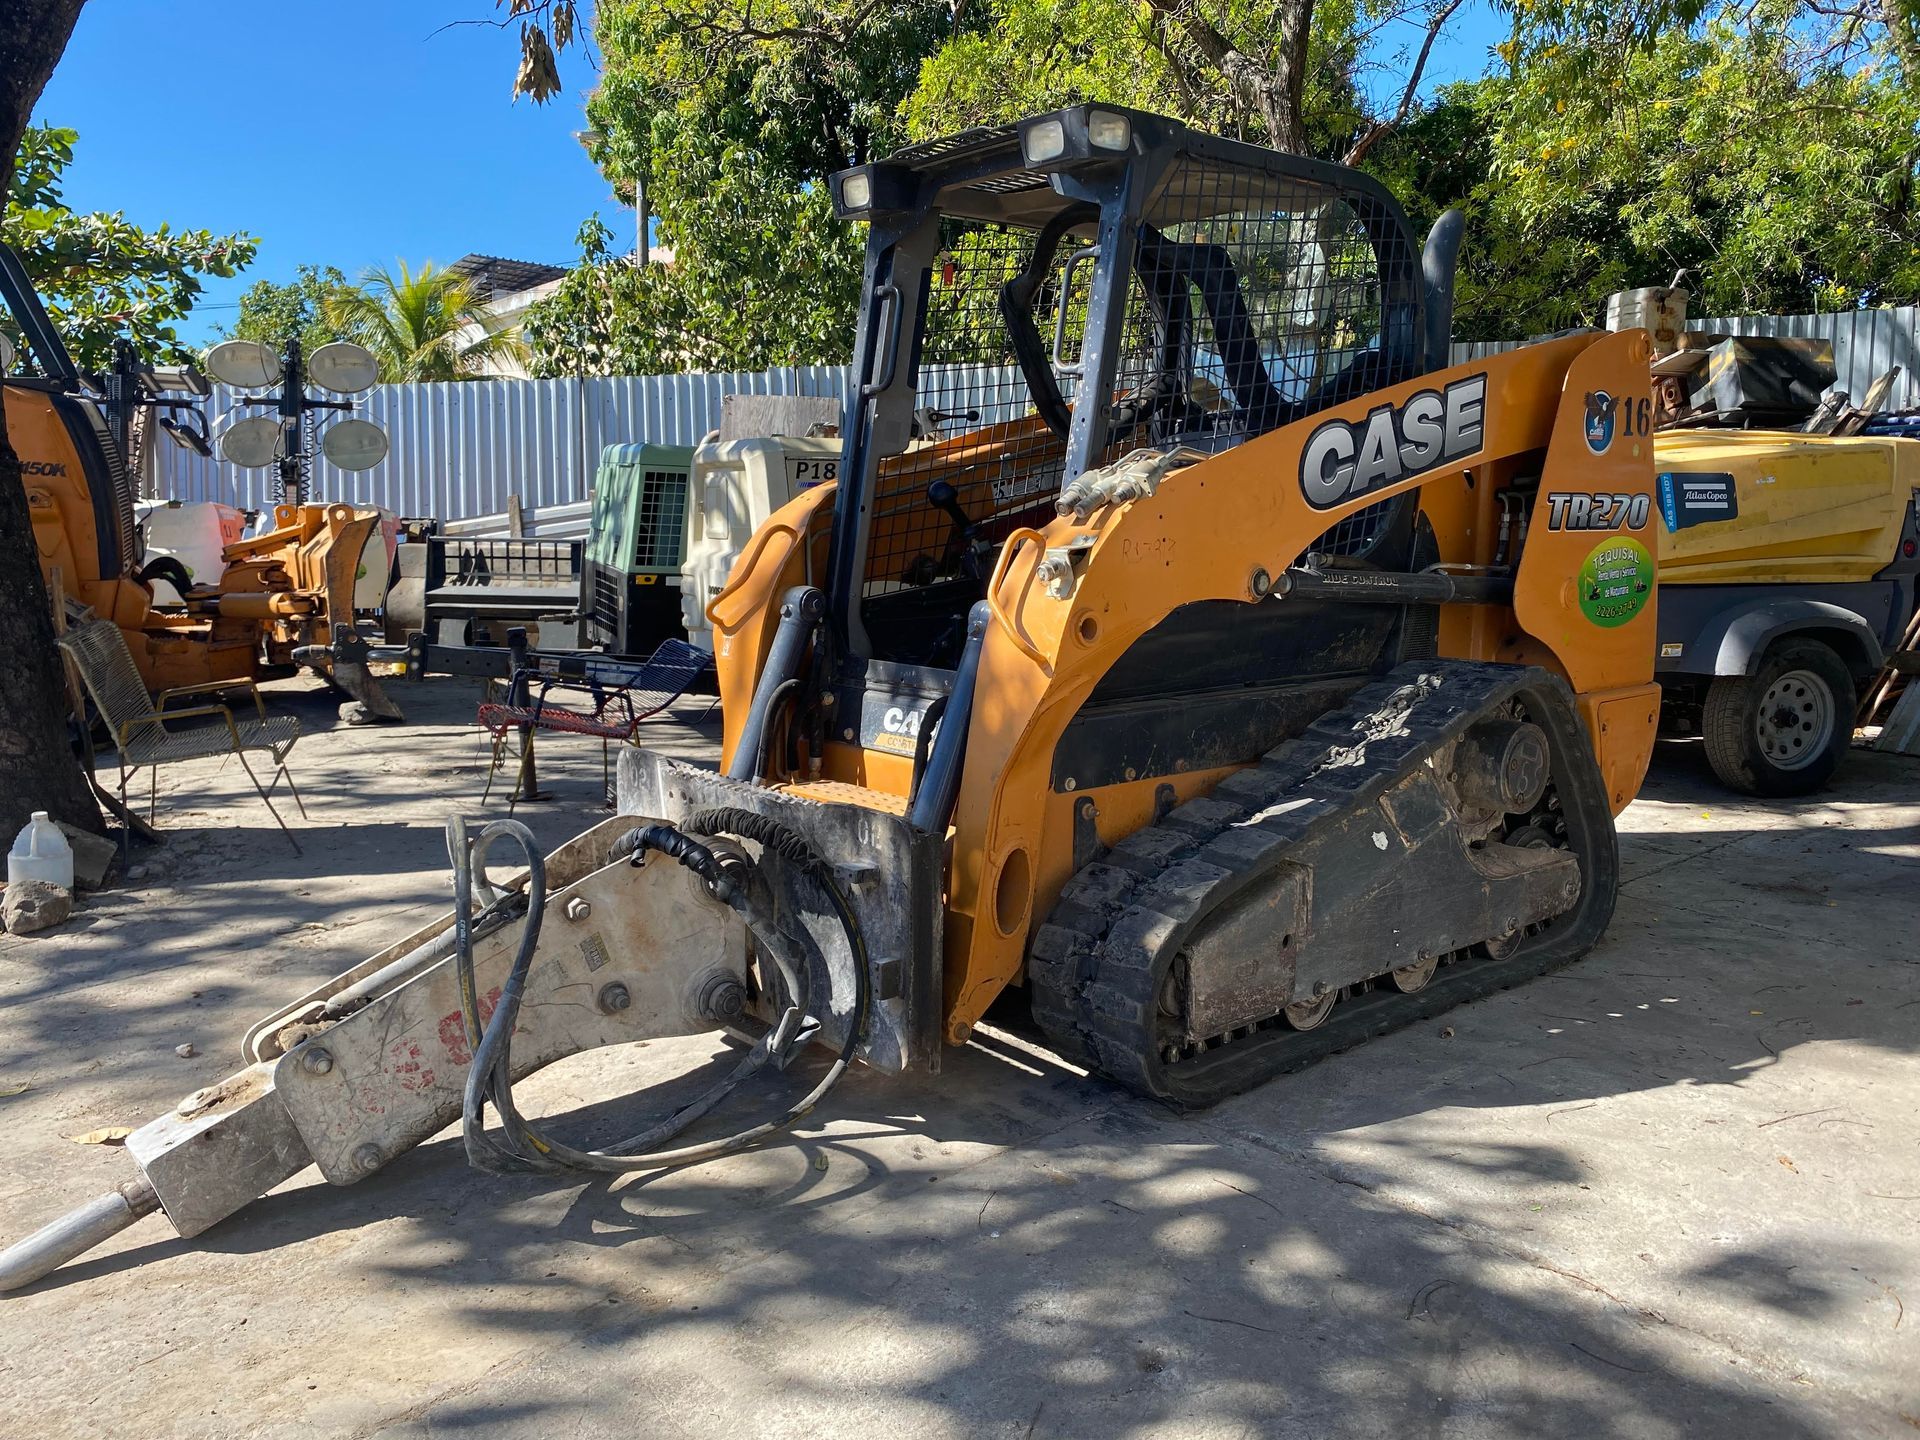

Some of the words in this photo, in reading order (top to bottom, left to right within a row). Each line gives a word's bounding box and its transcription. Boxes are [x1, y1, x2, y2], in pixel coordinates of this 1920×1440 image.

[1624, 397, 1651, 437] 16
[1300, 375, 1486, 507] CASE
[1663, 476, 1671, 492] KD7
[1547, 492, 1651, 531] TR270
[1667, 510, 1675, 527] XAS
[1593, 547, 1640, 569] TEQUISAL
[1596, 598, 1637, 618] 2226-2749
[883, 706, 930, 738] CA
